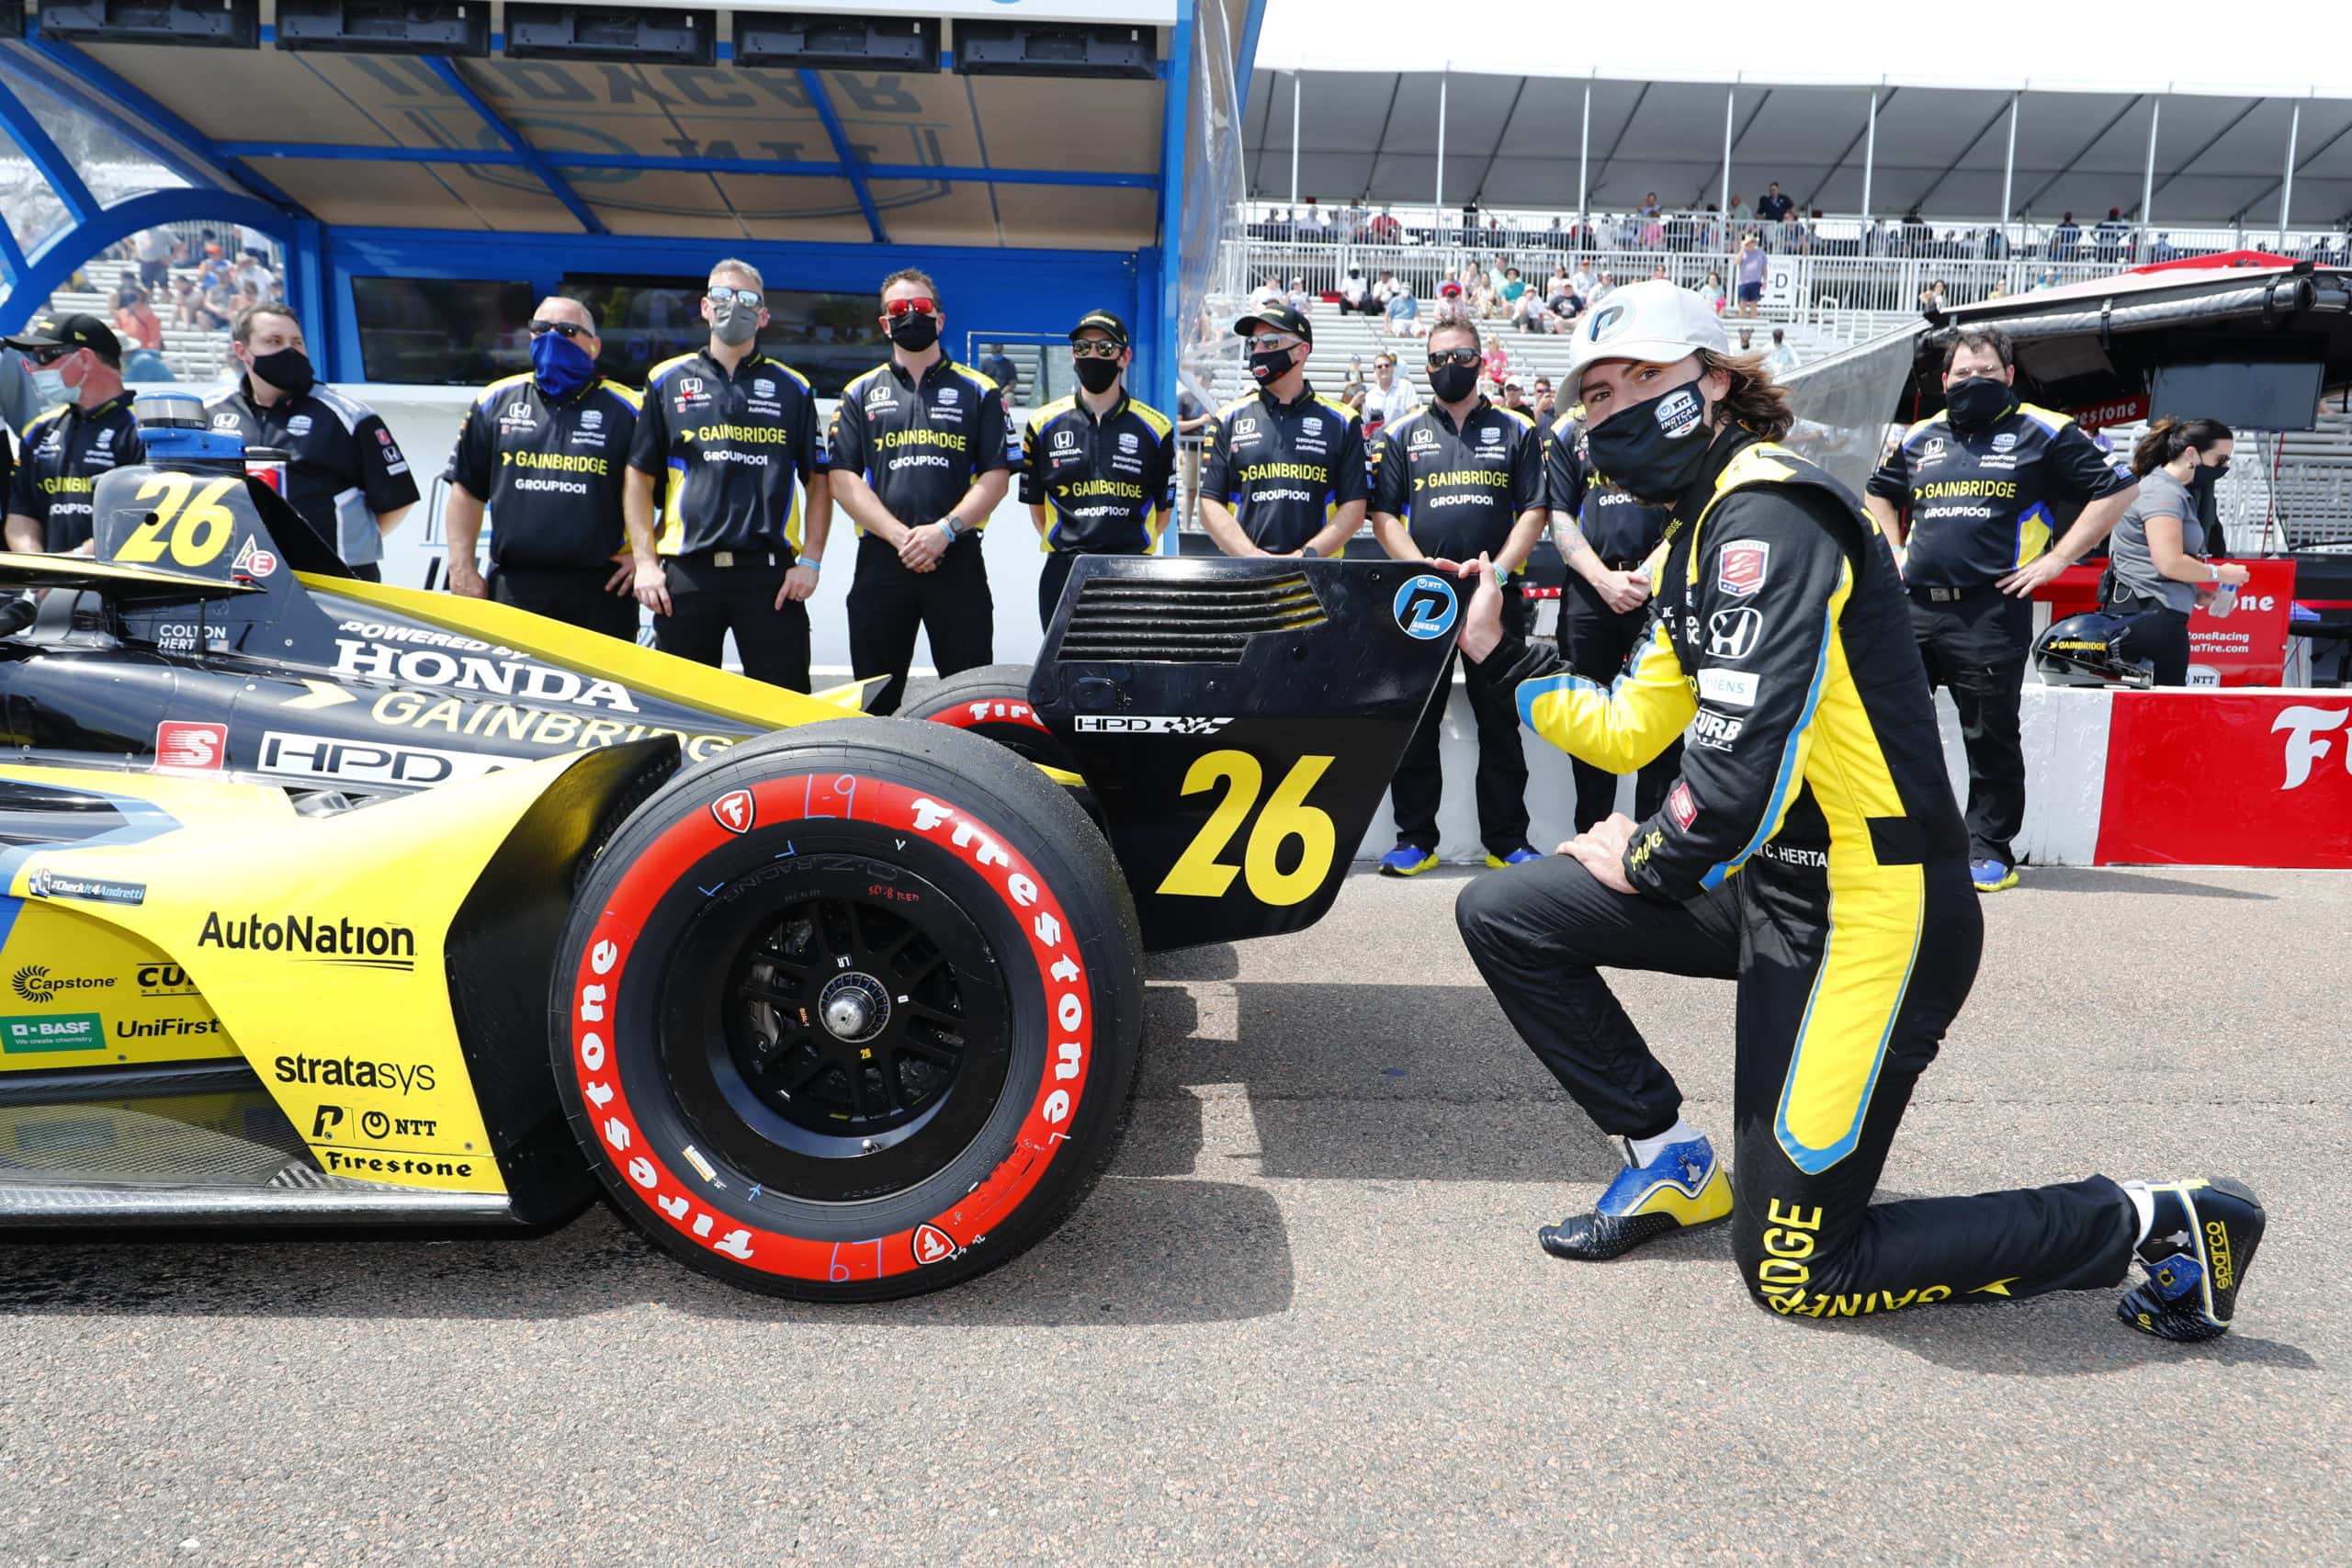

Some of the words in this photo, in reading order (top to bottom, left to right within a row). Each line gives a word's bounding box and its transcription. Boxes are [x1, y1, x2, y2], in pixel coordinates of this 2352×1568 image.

[1660, 404, 1699, 430] INDYCAR
[698, 423, 787, 446] GAINBRIDGE
[885, 429, 967, 452] GAINBRIDGE
[514, 450, 608, 476] GAINBRIDGE
[703, 450, 768, 467] GROUP1001
[1248, 462, 1329, 484] GAINBRIDGE
[1428, 469, 1510, 489] GAINBRIDGE
[514, 478, 587, 495] GROUP1001
[1251, 489, 1311, 502] GROUP1001
[1925, 479, 2018, 499] GAINBRIDGE
[1430, 493, 1494, 508] GROUP1001
[113, 471, 244, 568] 26
[1924, 506, 1992, 520] GROUP1001
[338, 620, 491, 653] POWERED
[2058, 641, 2107, 651] GAINBRIDGE
[329, 637, 639, 714] HONDA
[2192, 675, 2215, 684] NTT
[1077, 718, 1151, 731] HPD
[266, 738, 456, 784] HPD
[1155, 749, 1336, 907] 26
[1765, 848, 1778, 861] C.
[1780, 849, 1828, 868] HERTA
[197, 910, 415, 957] AutoNation
[910, 796, 1084, 1125] Firestone
[28, 976, 118, 992] Capstone
[137, 966, 195, 987] CU
[40, 1021, 91, 1035] BASF
[116, 1018, 220, 1038] UniFirst
[274, 1052, 436, 1096] stratasys
[579, 938, 755, 1264] Firestone
[395, 1119, 437, 1137] NTT
[324, 1151, 473, 1178] Firestone
